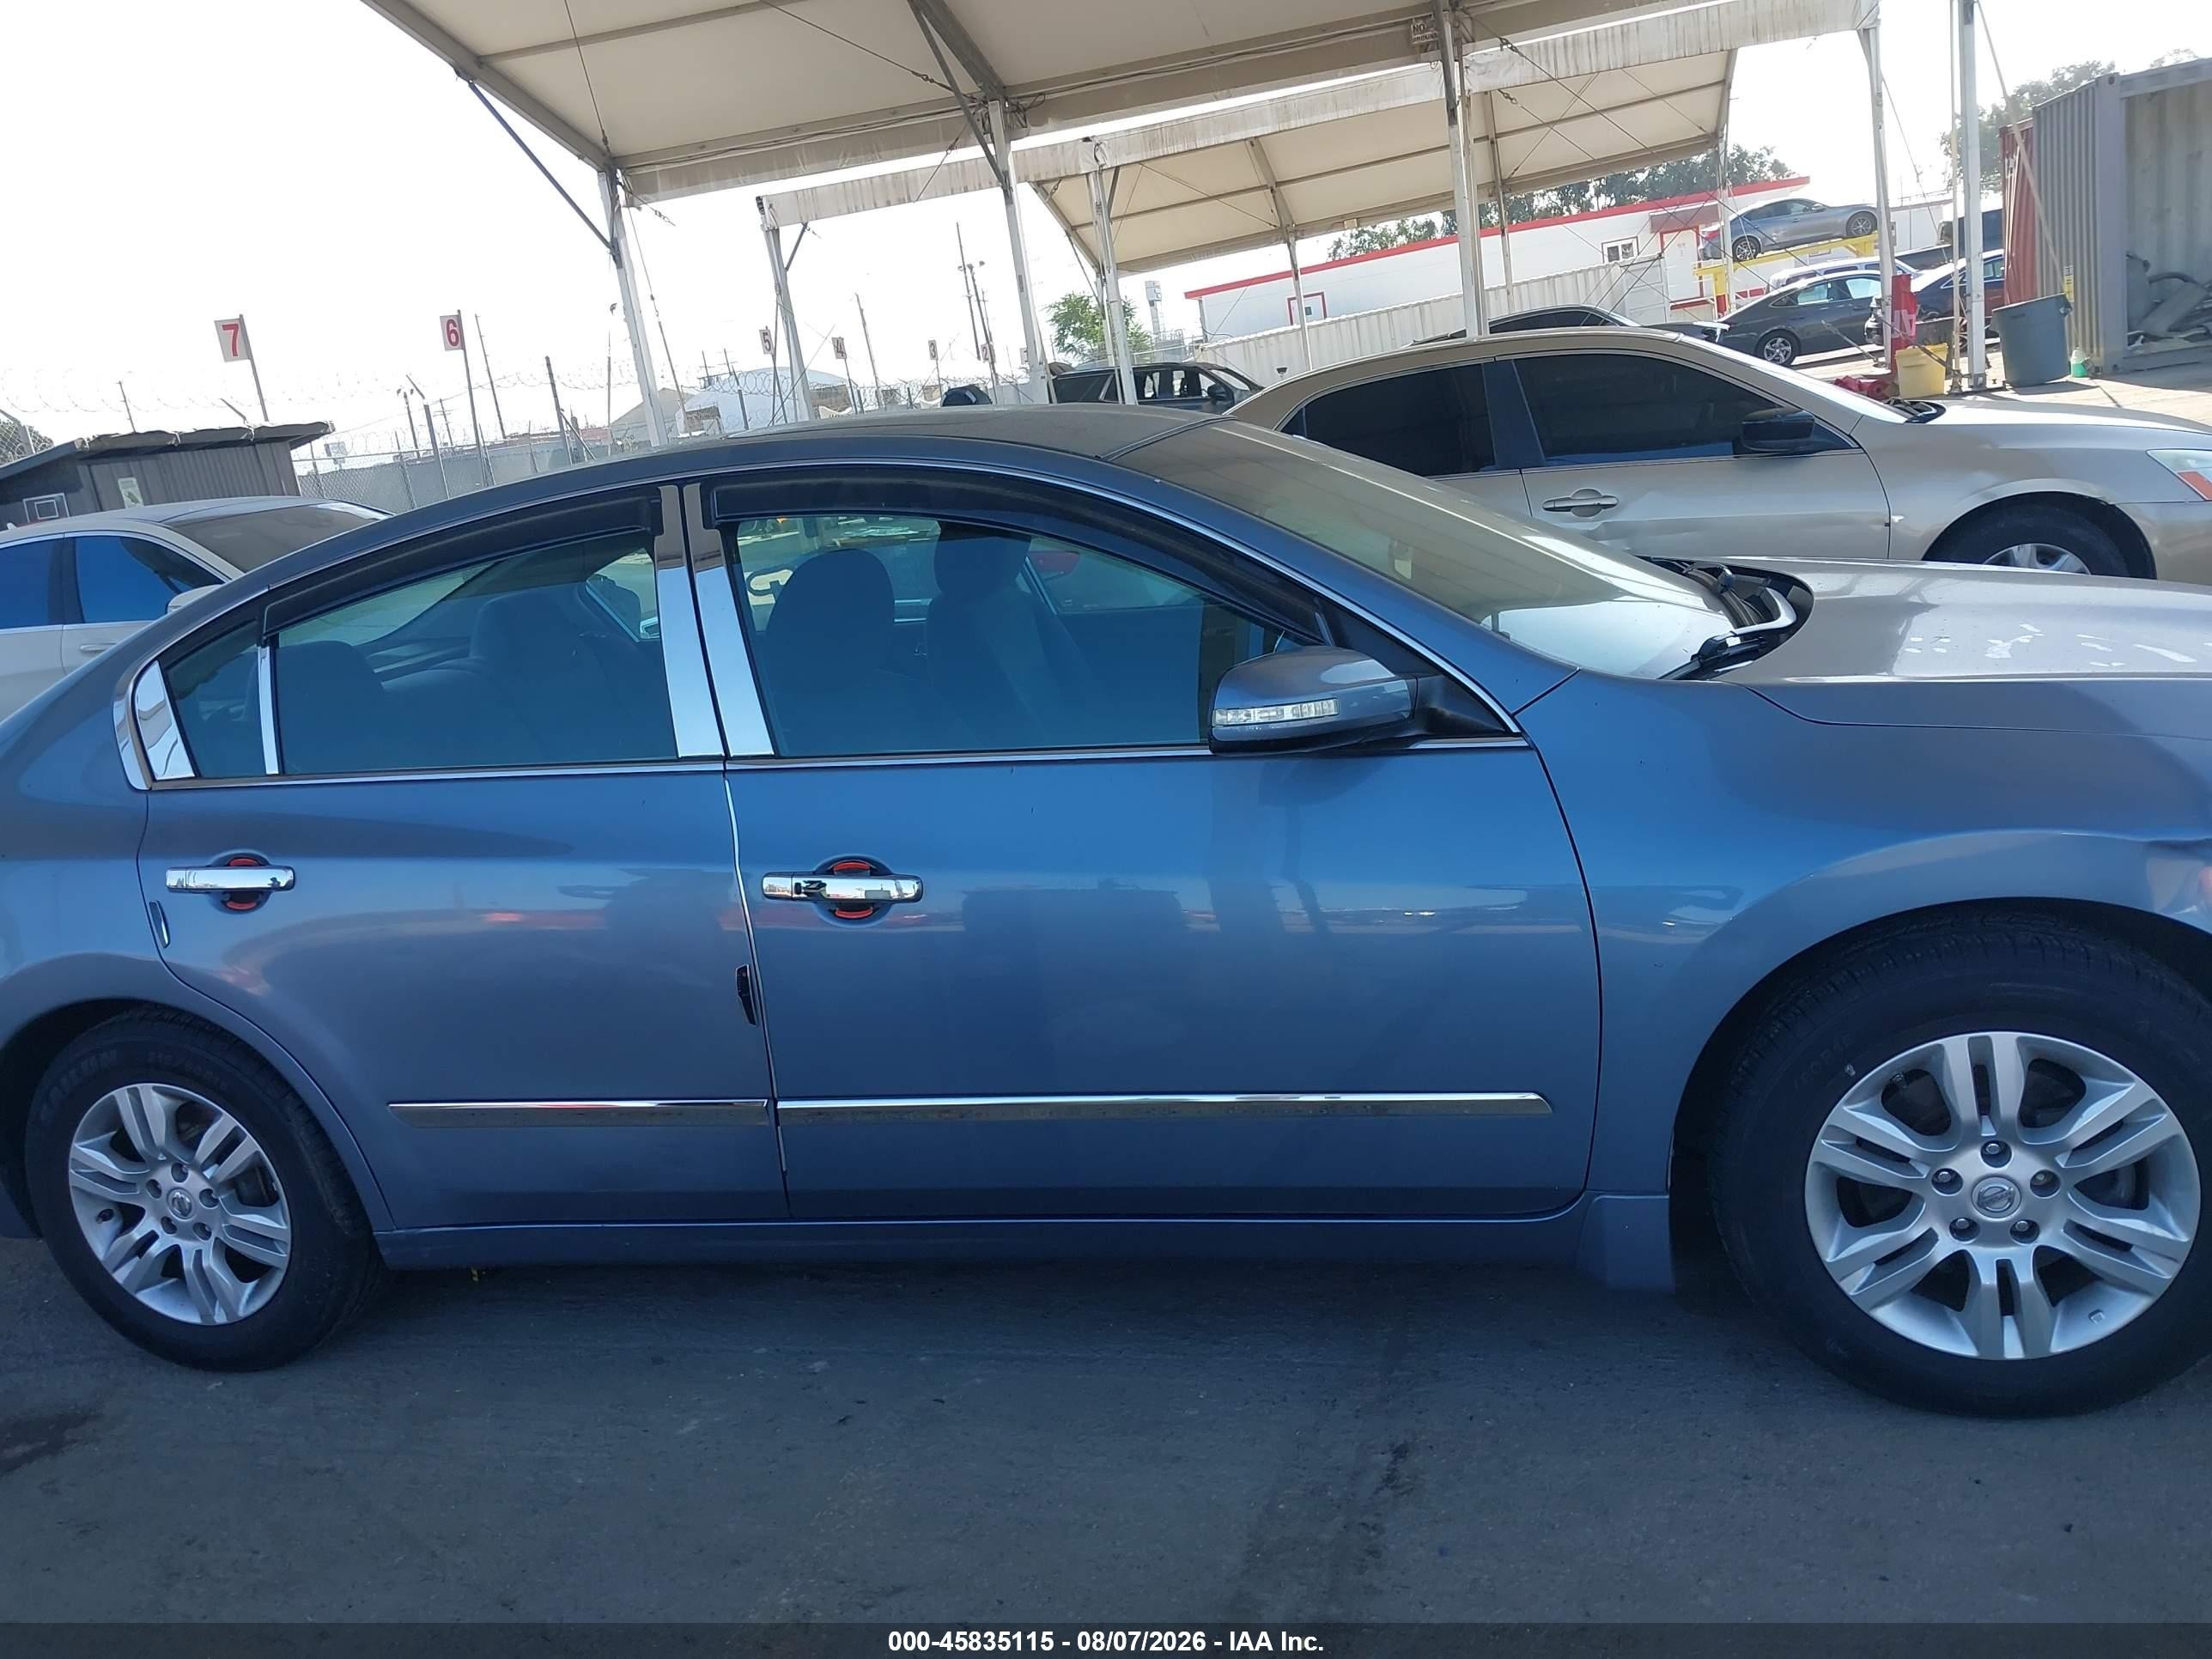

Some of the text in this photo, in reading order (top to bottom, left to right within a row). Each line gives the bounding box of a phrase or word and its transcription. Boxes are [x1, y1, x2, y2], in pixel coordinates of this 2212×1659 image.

[1413, 23, 1425, 33] NO
[222, 324, 239, 357] 7
[447, 319, 459, 347] 6
[762, 331, 771, 352] 5
[836, 339, 844, 358] 4
[929, 343, 936, 358] 3
[982, 346, 989, 361] 2
